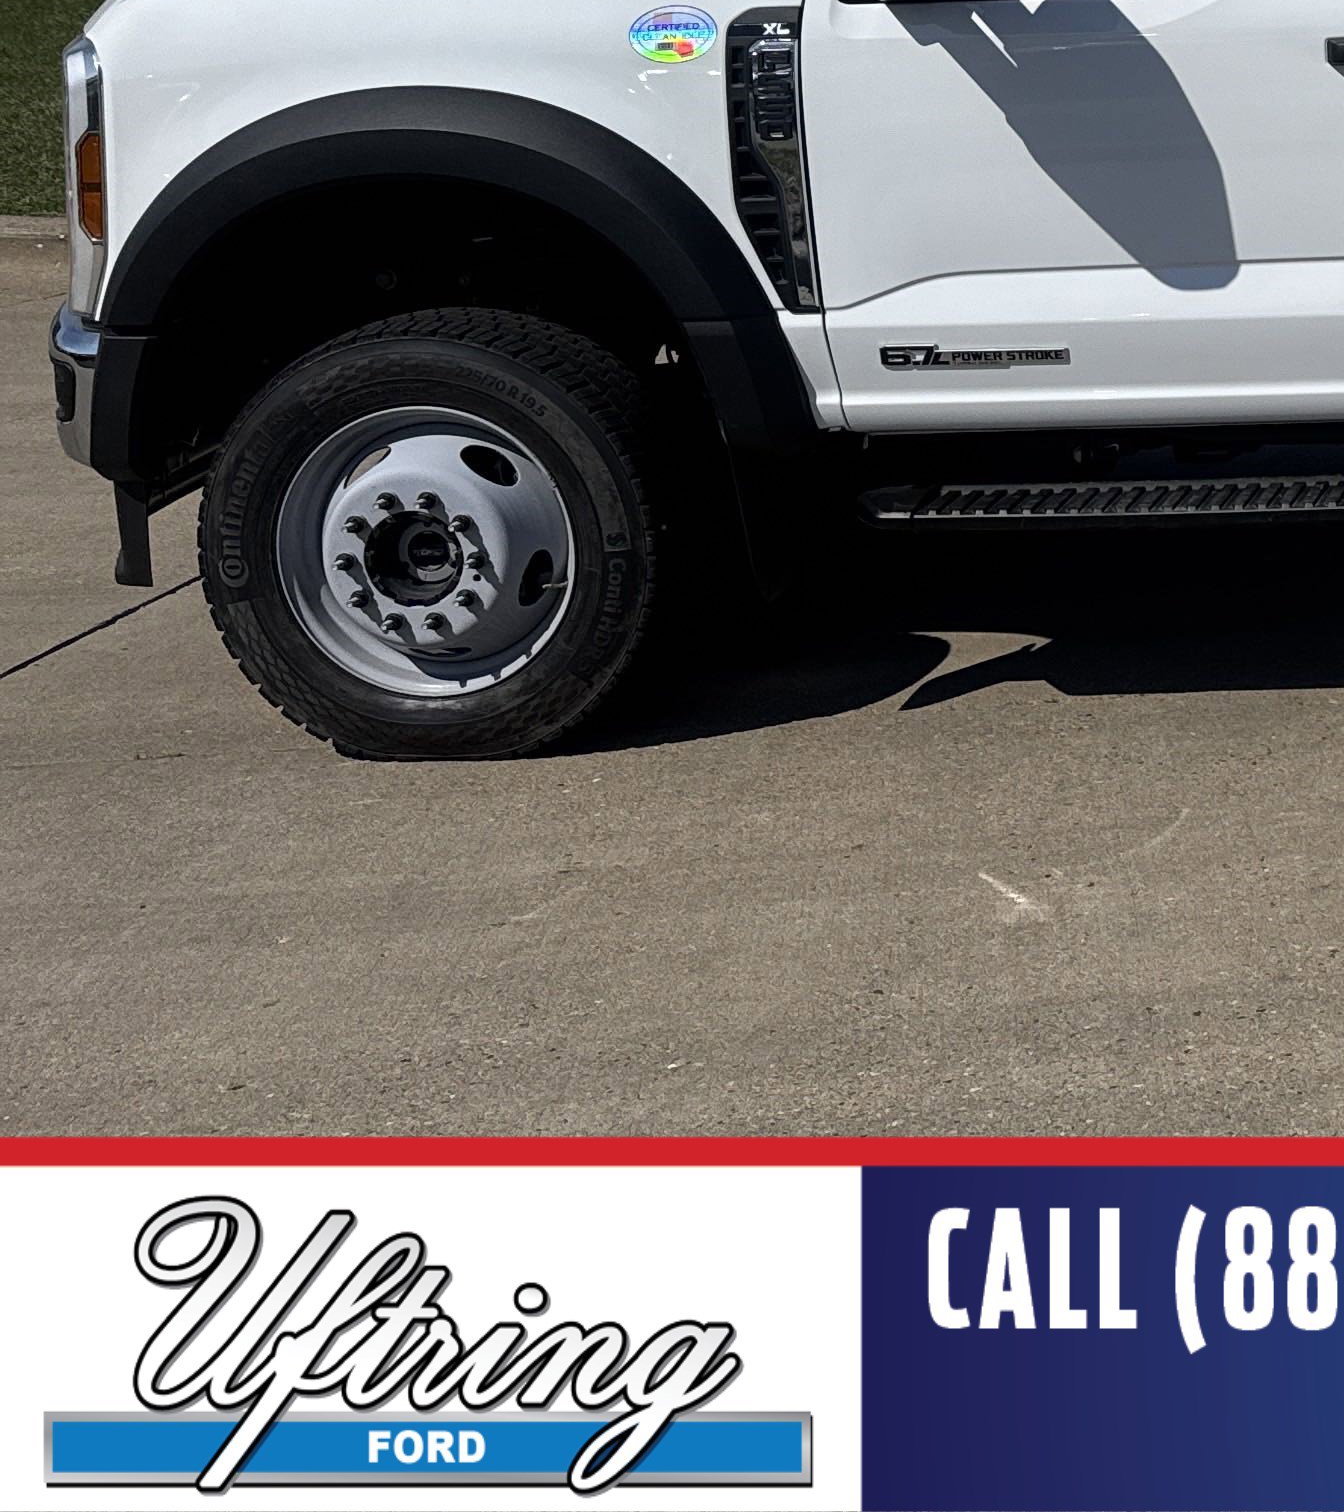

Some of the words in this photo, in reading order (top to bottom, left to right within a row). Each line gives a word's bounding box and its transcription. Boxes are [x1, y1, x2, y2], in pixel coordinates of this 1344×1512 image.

[648, 23, 700, 32] CERTIFIED
[762, 22, 790, 35] XL
[952, 351, 1004, 361] POWER
[1006, 349, 1064, 360] STROKE
[507, 385, 519, 399] R
[520, 392, 547, 417] 19.5
[218, 427, 273, 588] Continental
[603, 557, 626, 614] Conti
